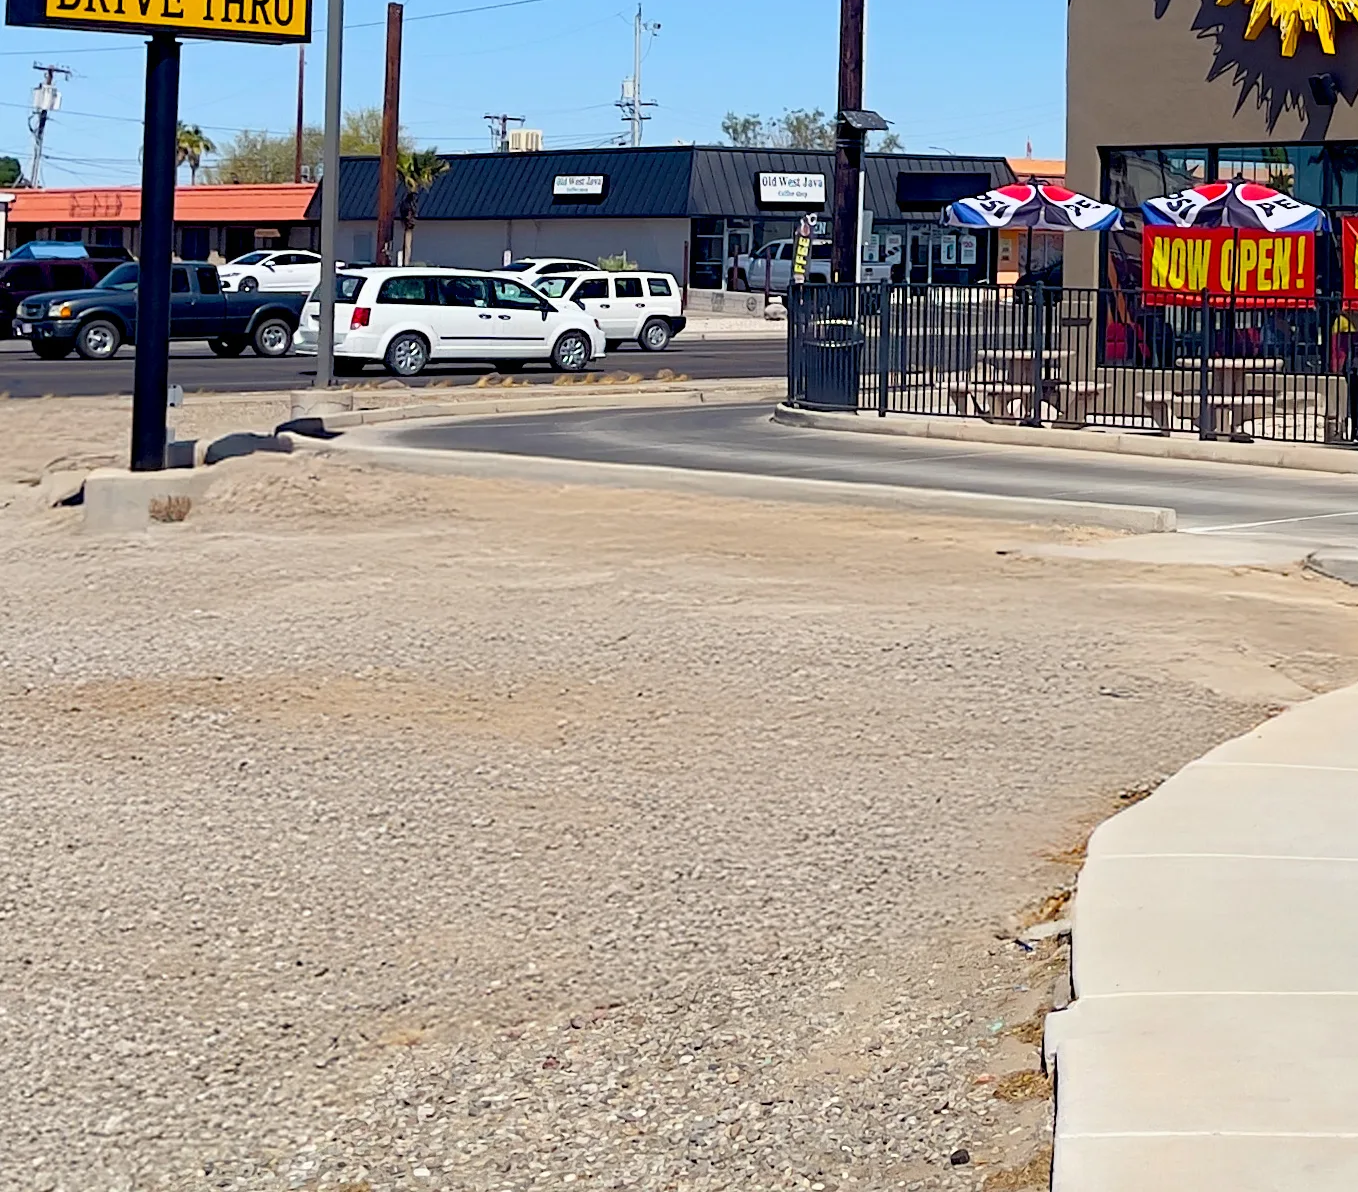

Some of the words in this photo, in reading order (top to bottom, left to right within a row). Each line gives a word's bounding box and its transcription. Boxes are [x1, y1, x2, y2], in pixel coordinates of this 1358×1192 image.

[762, 176, 777, 187] Old
[779, 176, 800, 188] West
[803, 177, 823, 188] Java
[1151, 236, 1212, 291] NOW
